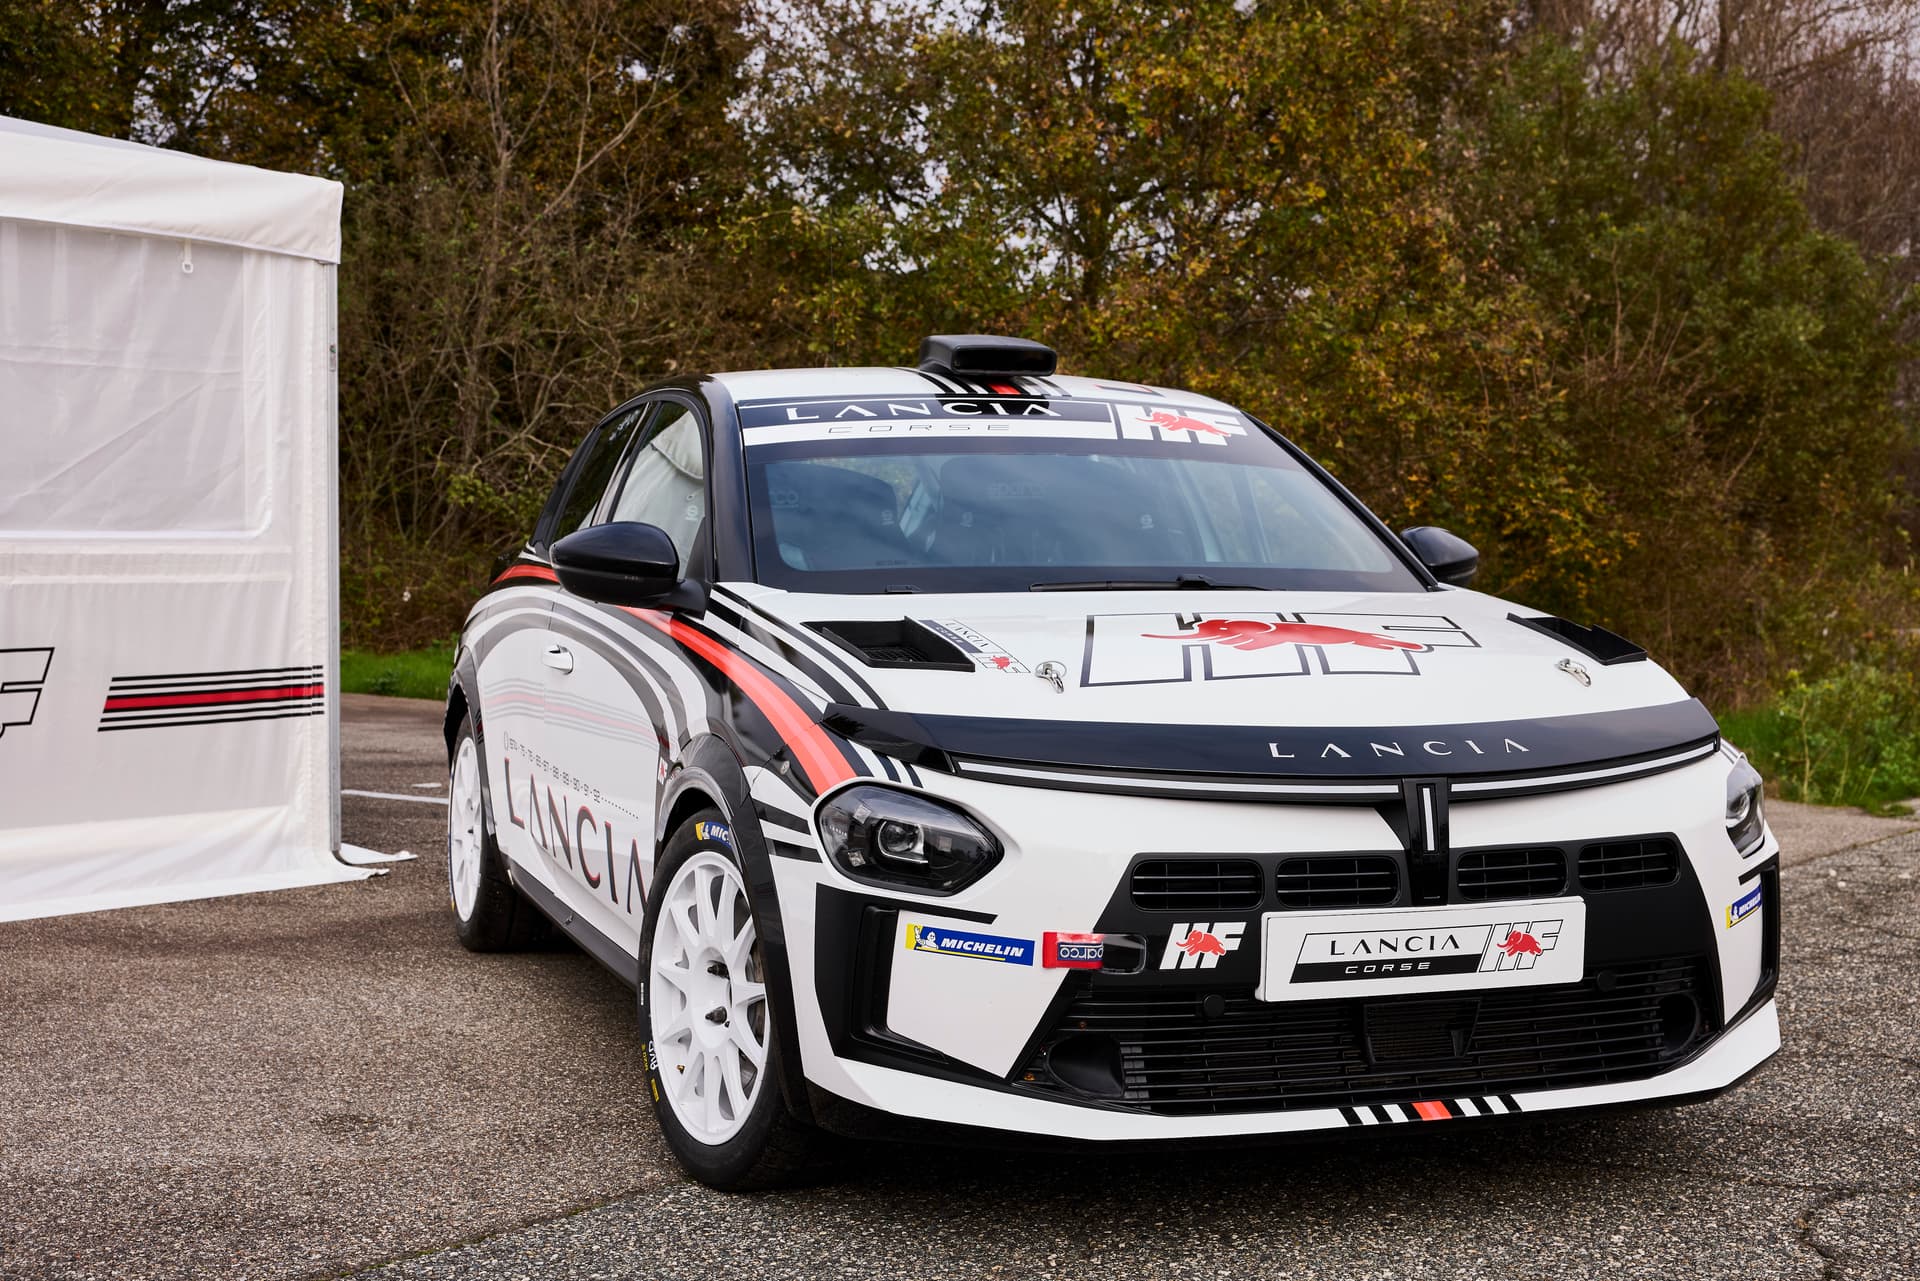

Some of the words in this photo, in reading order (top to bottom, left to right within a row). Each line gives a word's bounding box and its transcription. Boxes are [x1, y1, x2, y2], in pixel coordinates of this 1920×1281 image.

[785, 402, 1062, 421] LANCIA
[828, 424, 1010, 434] CORSE
[1268, 737, 1530, 759] LANCIA
[504, 757, 647, 915] LANCIA
[940, 937, 1024, 957] MICHELIN
[1059, 941, 1104, 960] parco
[1330, 934, 1460, 956] LANCIA
[1344, 961, 1431, 974] CORSE
